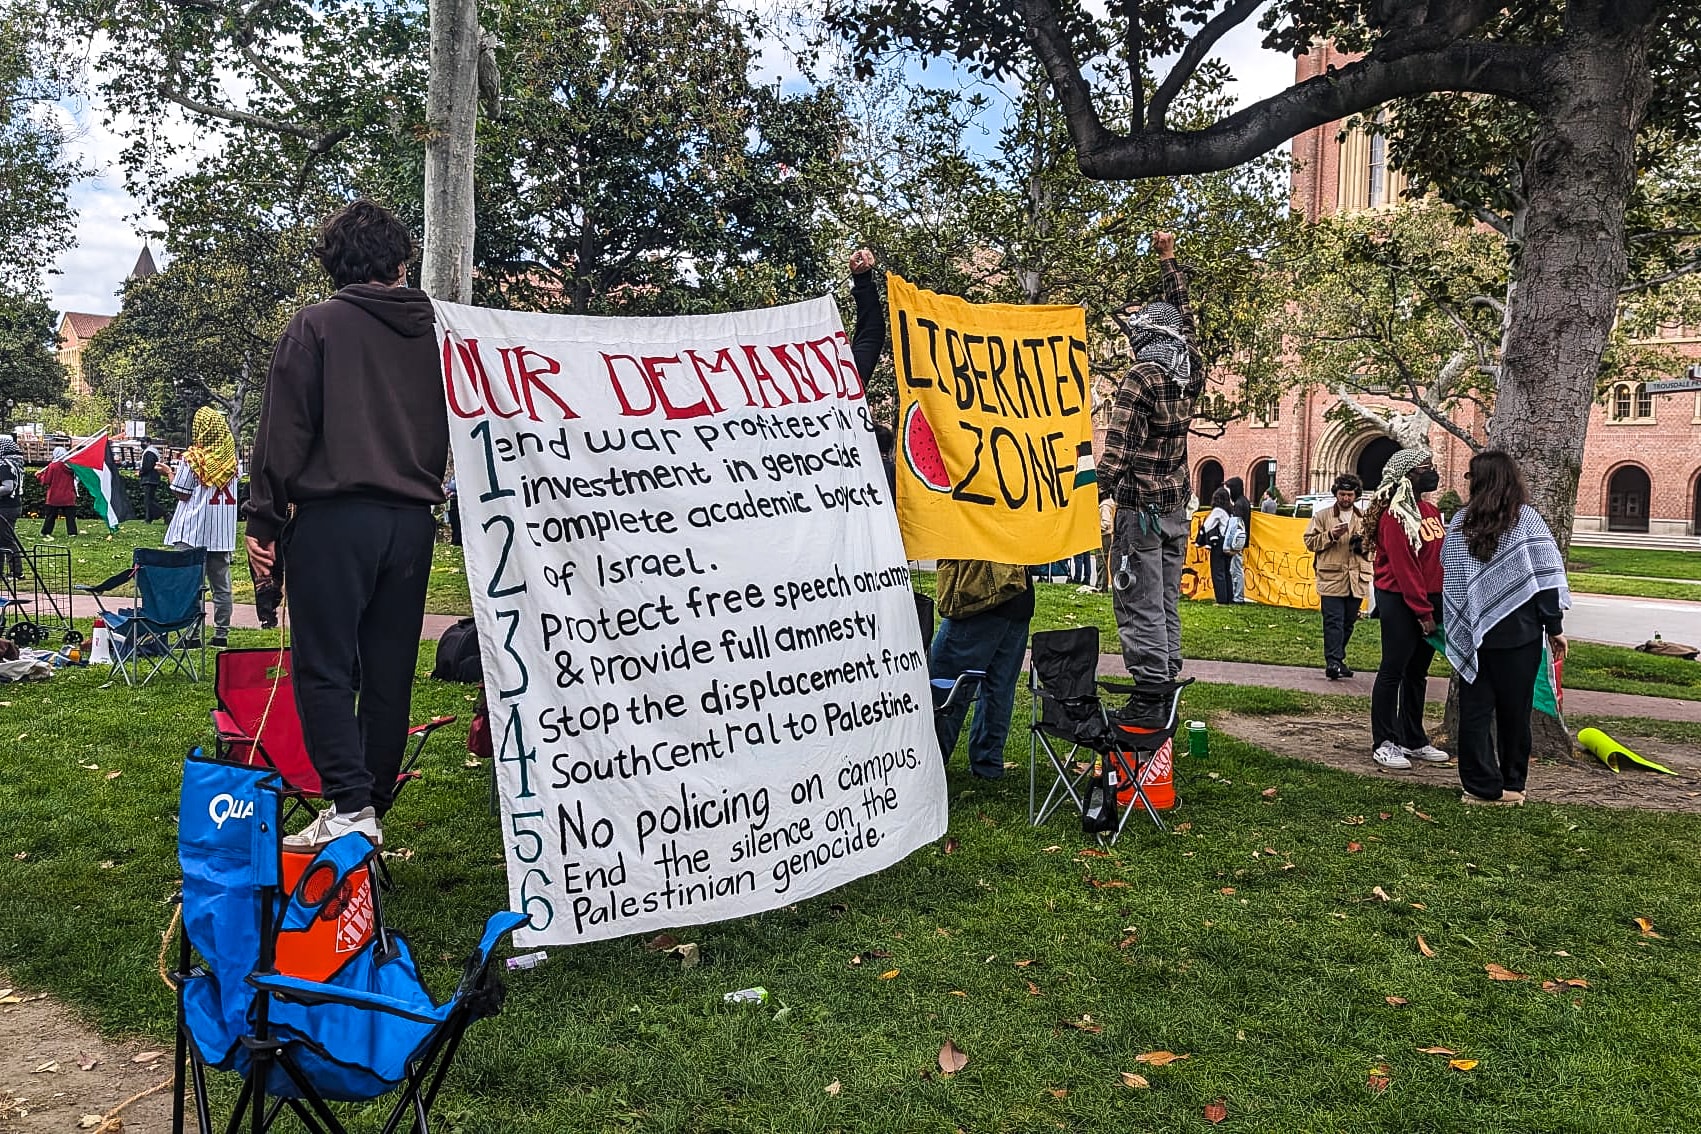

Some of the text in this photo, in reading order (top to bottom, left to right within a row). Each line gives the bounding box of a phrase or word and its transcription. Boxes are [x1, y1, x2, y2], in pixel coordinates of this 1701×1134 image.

[443, 330, 865, 422] OUR DEMANDS
[1653, 381, 1690, 389] TROUSDALE
[470, 406, 875, 502] 1 end war profiteerin &
[521, 442, 862, 507] investment in genocide
[951, 420, 1075, 512] ZONE
[482, 515, 527, 598] 2
[687, 489, 812, 527] academic
[543, 547, 718, 595] of Israel.
[496, 609, 528, 700] 3
[686, 583, 765, 619] free
[773, 563, 852, 610] speech
[854, 571, 876, 592] on
[554, 650, 584, 688] &
[590, 634, 715, 686] provide
[719, 624, 771, 662] full
[500, 648, 922, 798] 4 Stop the displacement from
[783, 712, 817, 741] to
[823, 691, 919, 737] Palestine.
[511, 747, 922, 864] 5 No policing on campus.
[563, 786, 899, 894] End the silence on the
[520, 822, 885, 934] 6 Palestinian genocide.
